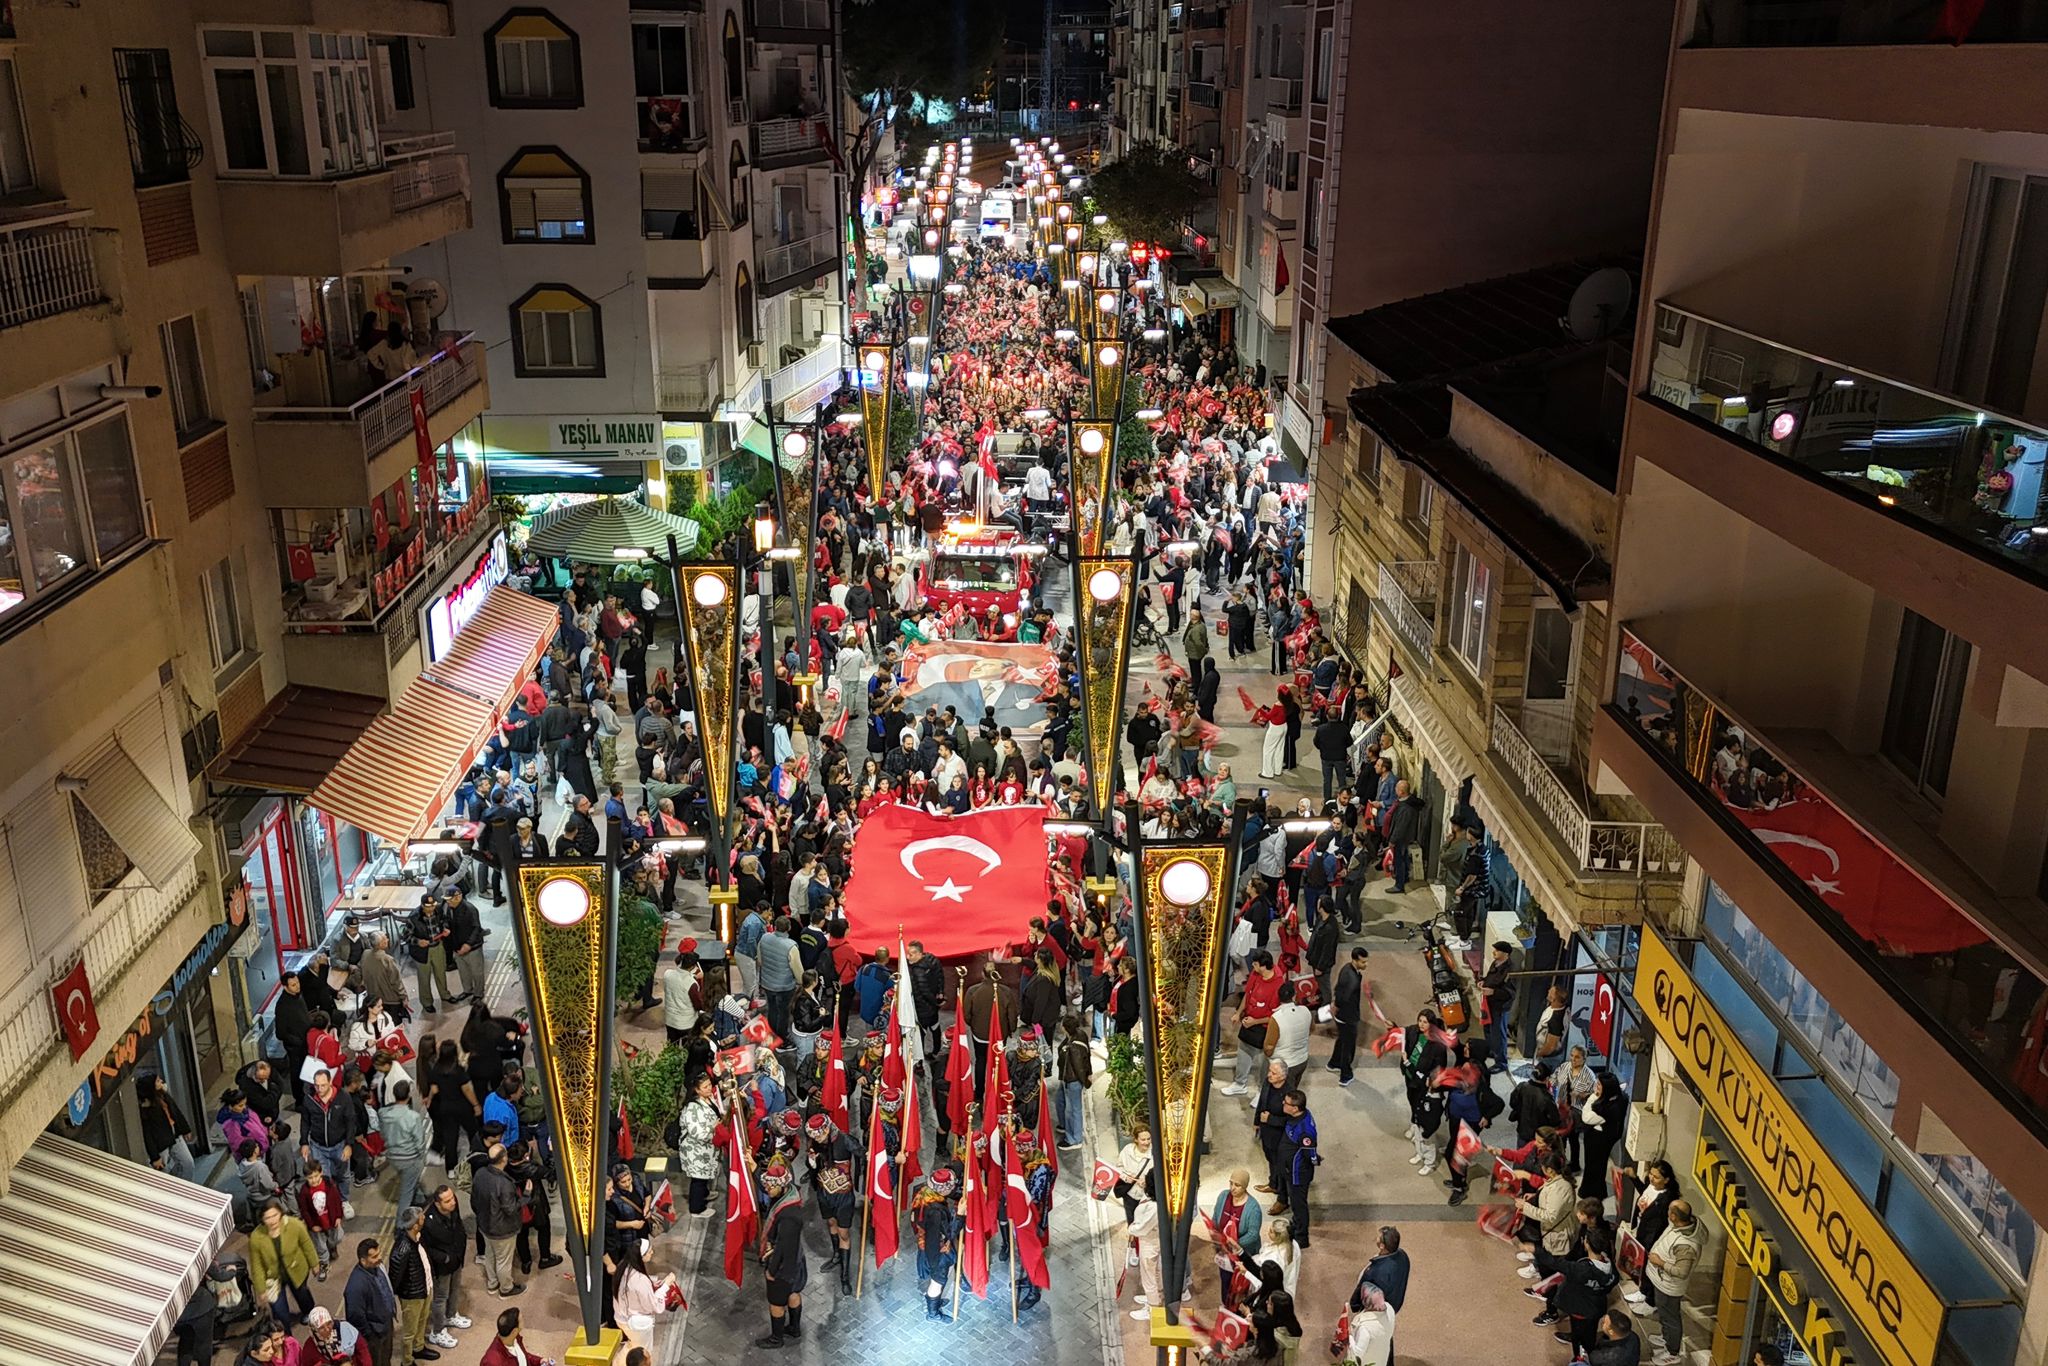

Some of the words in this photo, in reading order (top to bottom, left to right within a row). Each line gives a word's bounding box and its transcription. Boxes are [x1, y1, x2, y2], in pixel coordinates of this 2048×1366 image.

[558, 417, 601, 450] YEŞİL
[604, 422, 655, 445] MANAV
[1577, 988, 1594, 997] HOŞ
[93, 1032, 137, 1098] King
[138, 1004, 151, 1037] of
